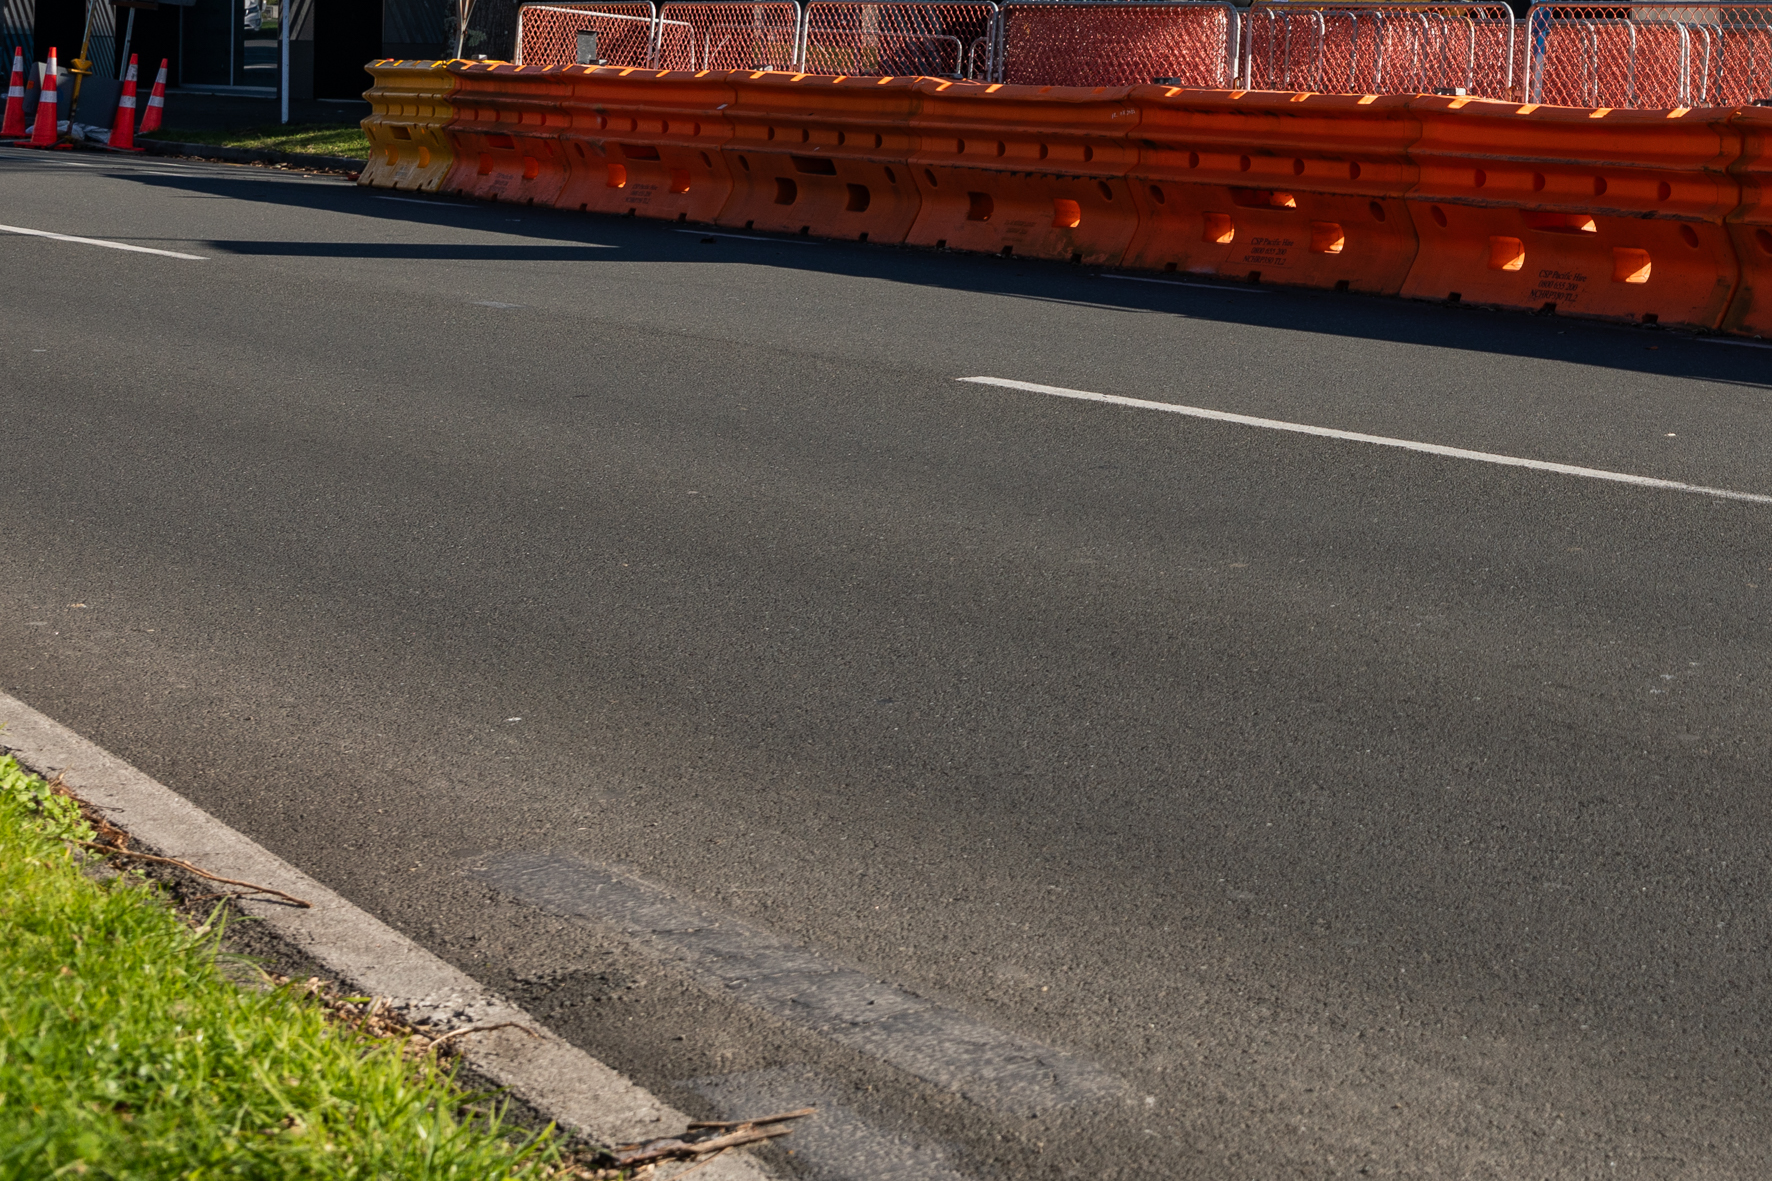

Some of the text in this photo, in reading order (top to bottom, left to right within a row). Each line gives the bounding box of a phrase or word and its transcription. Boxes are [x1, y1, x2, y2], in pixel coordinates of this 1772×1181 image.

[1538, 269, 1587, 283] CSP Pacific Hire
[1538, 279, 1579, 291] 0800 655 200
